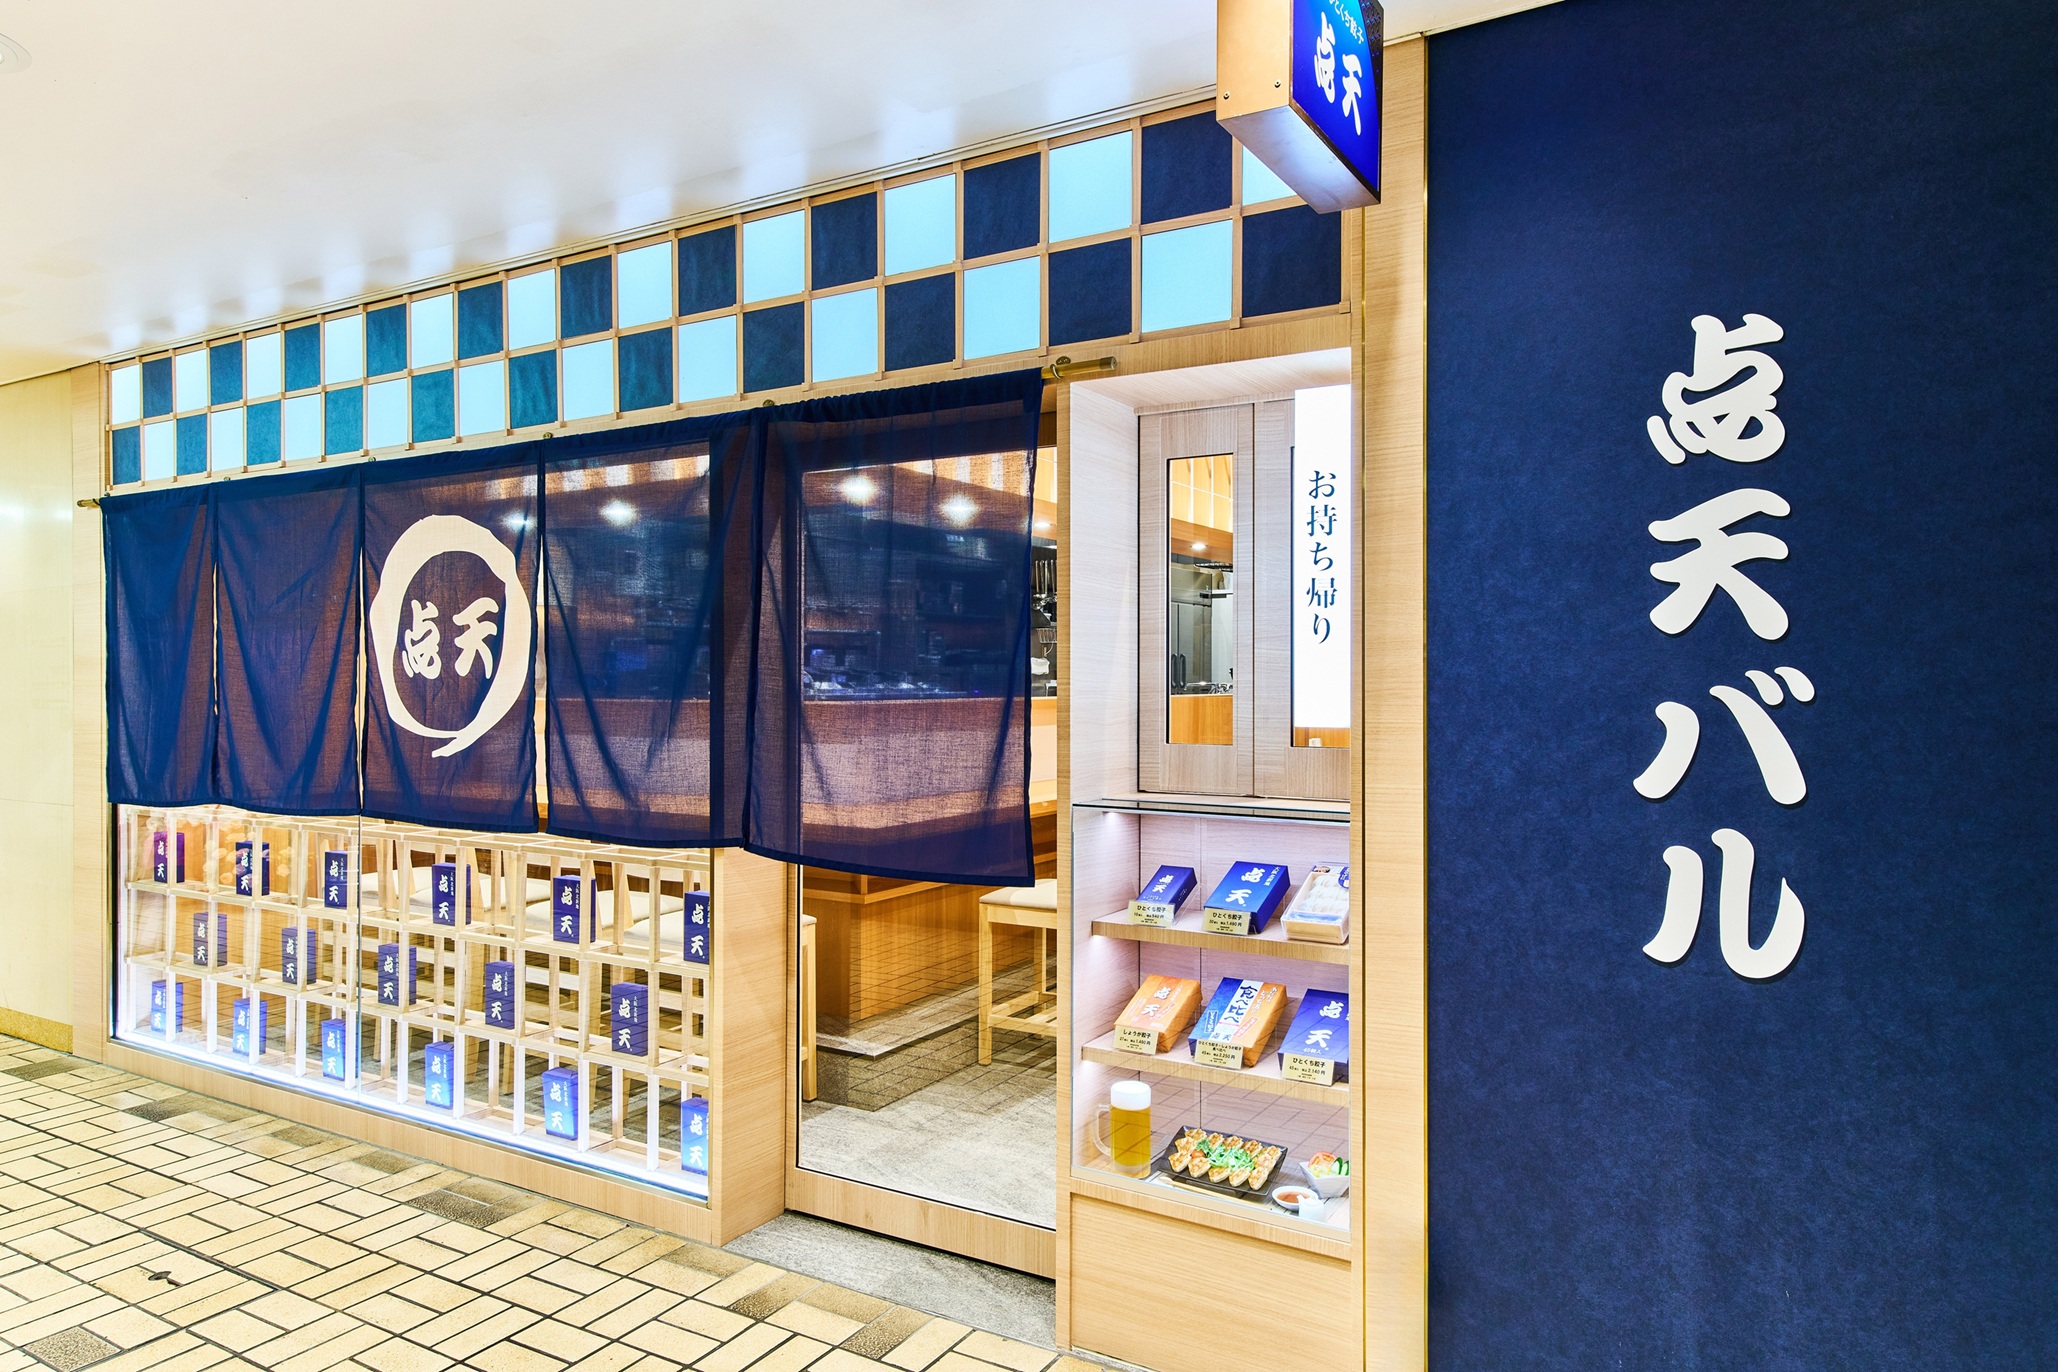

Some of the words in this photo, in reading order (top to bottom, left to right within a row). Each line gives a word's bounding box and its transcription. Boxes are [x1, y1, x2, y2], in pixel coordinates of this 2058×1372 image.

[1328, 0, 1364, 44] とくち餃子
[1306, 470, 1338, 645] お持ち帰り
[1633, 313, 1815, 980] 点天バル
[1137, 905, 1166, 913] ひとくち餃子
[1213, 912, 1243, 921] ひとくち餃子
[1224, 985, 1258, 1023] 食べ比べ
[1123, 1029, 1151, 1039] しょうが餃子
[1292, 1057, 1326, 1068] ひとくち餃子
